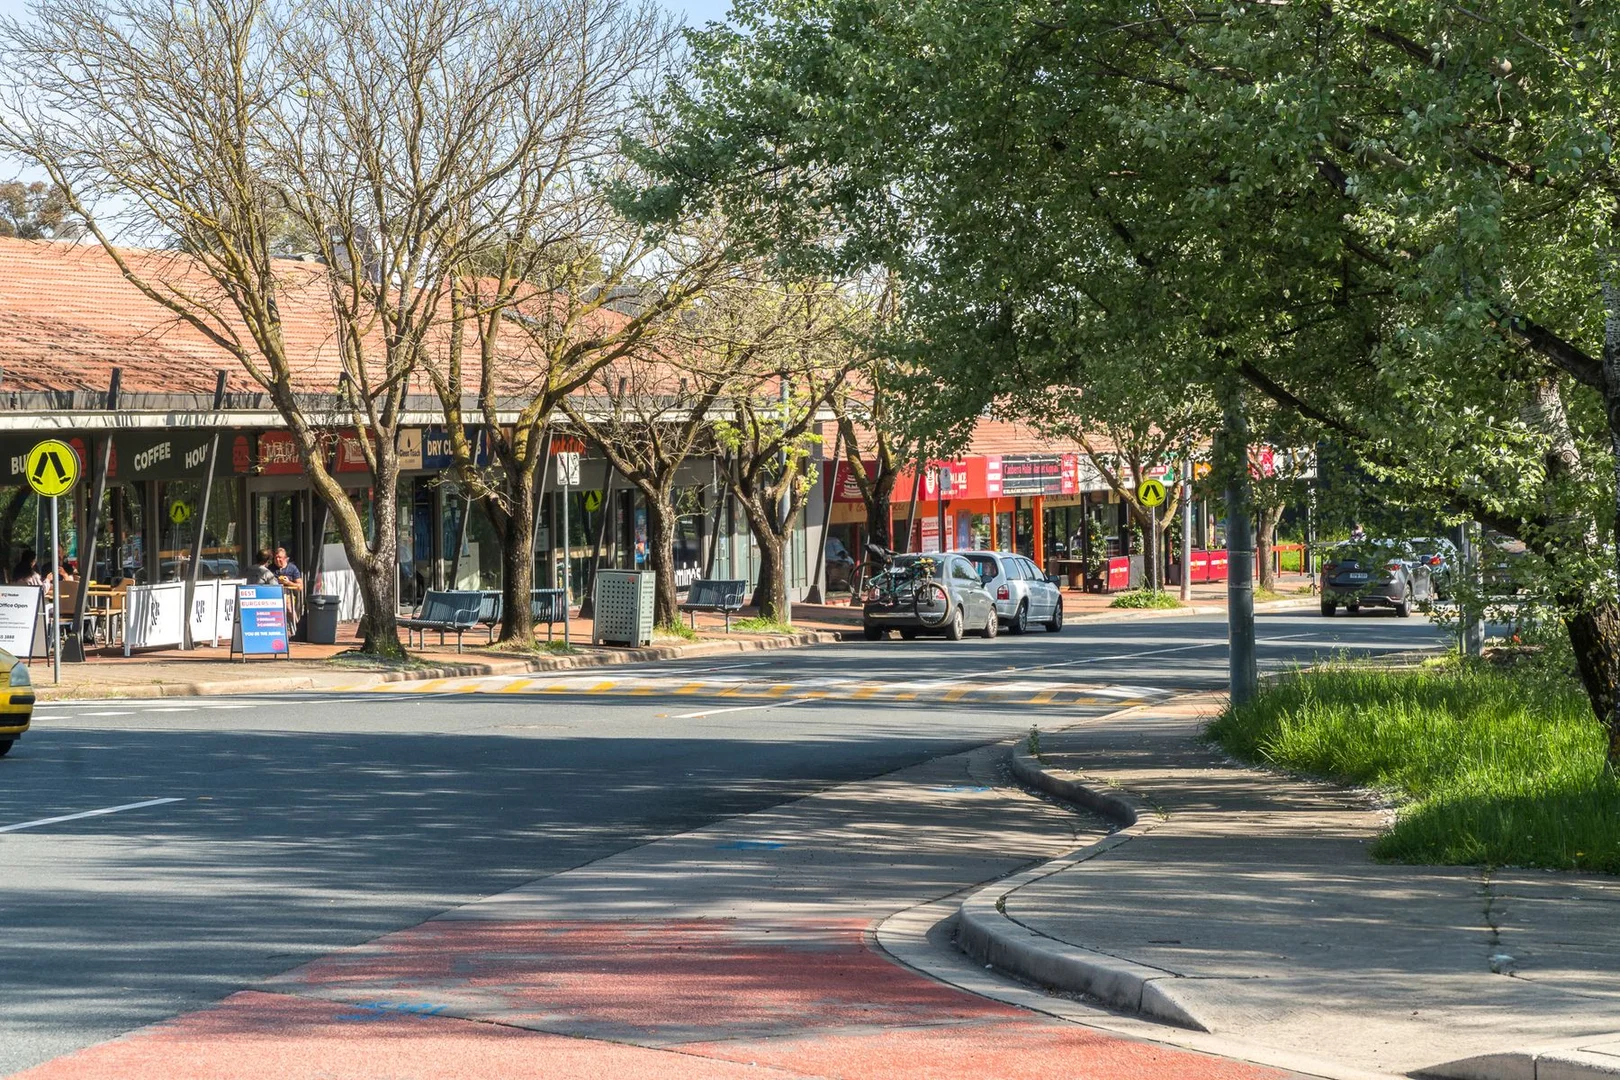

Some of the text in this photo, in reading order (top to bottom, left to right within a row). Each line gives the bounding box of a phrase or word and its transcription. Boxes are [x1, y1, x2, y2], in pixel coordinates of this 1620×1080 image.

[134, 442, 209, 471] COFFEE HOU
[427, 440, 441, 456] DRY
[11, 453, 29, 475] BU
[674, 560, 702, 587] mino's
